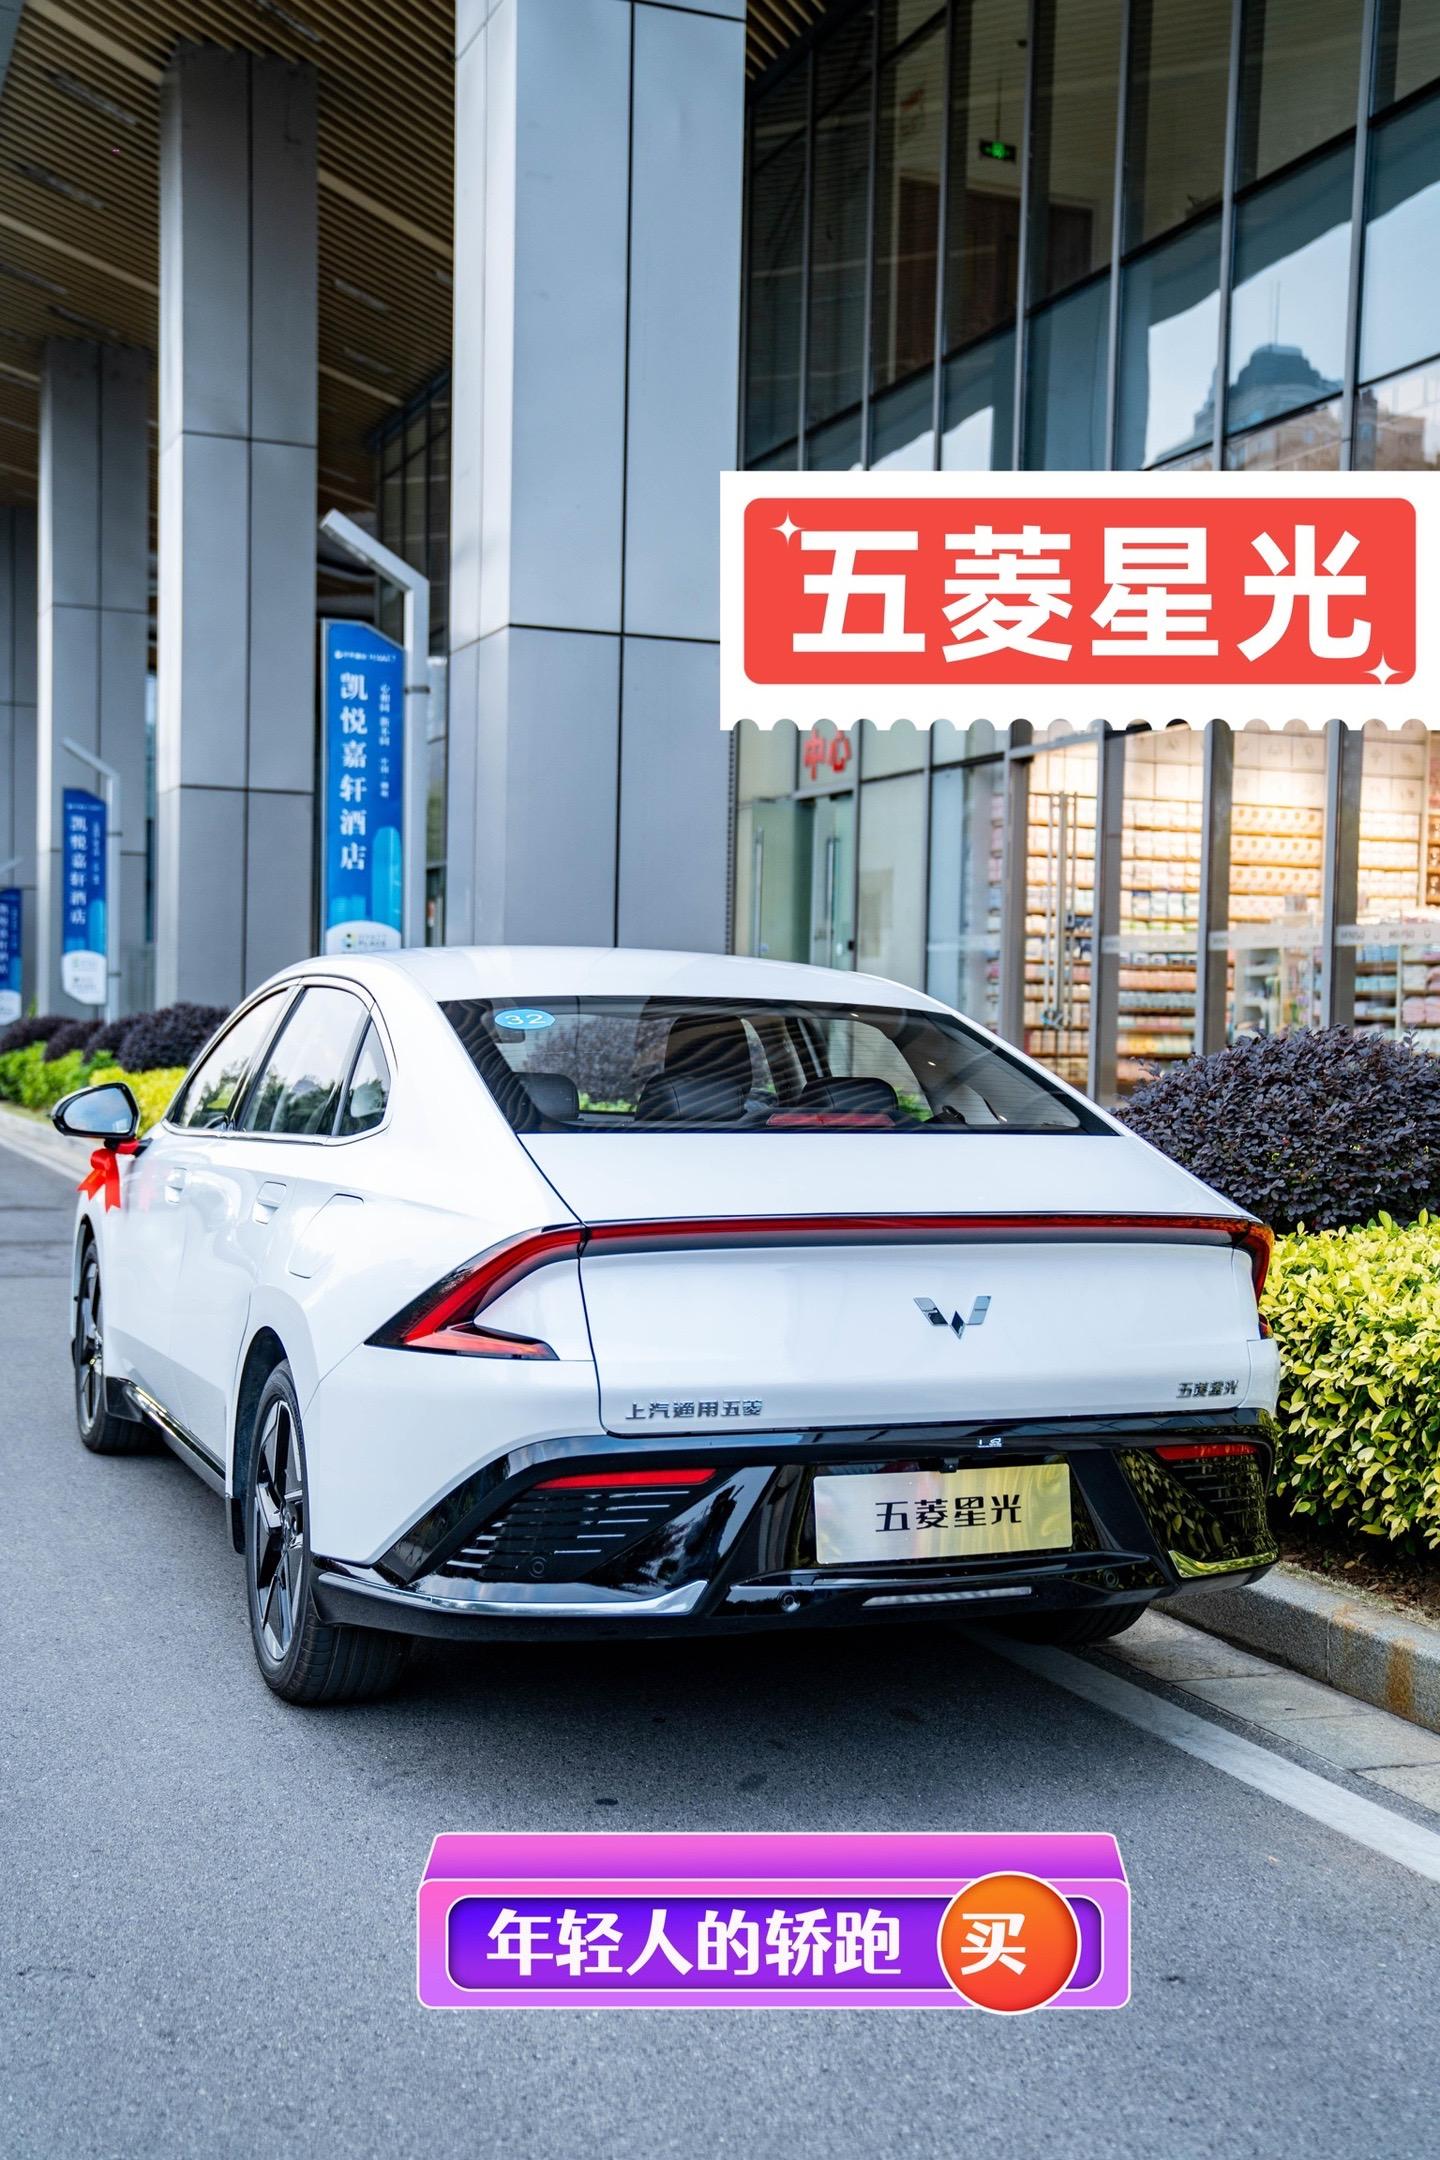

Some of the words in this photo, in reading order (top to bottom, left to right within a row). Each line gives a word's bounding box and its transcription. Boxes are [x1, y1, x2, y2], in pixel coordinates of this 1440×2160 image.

[803, 727, 852, 781] 中心
[339, 671, 369, 871] 凯悦嘉轩酒店
[505, 1014, 546, 1025] 32
[1176, 1380, 1239, 1398] 五菱星光
[625, 1399, 763, 1420] 上汽通用五菱
[875, 1494, 1022, 1533] 五菱星光
